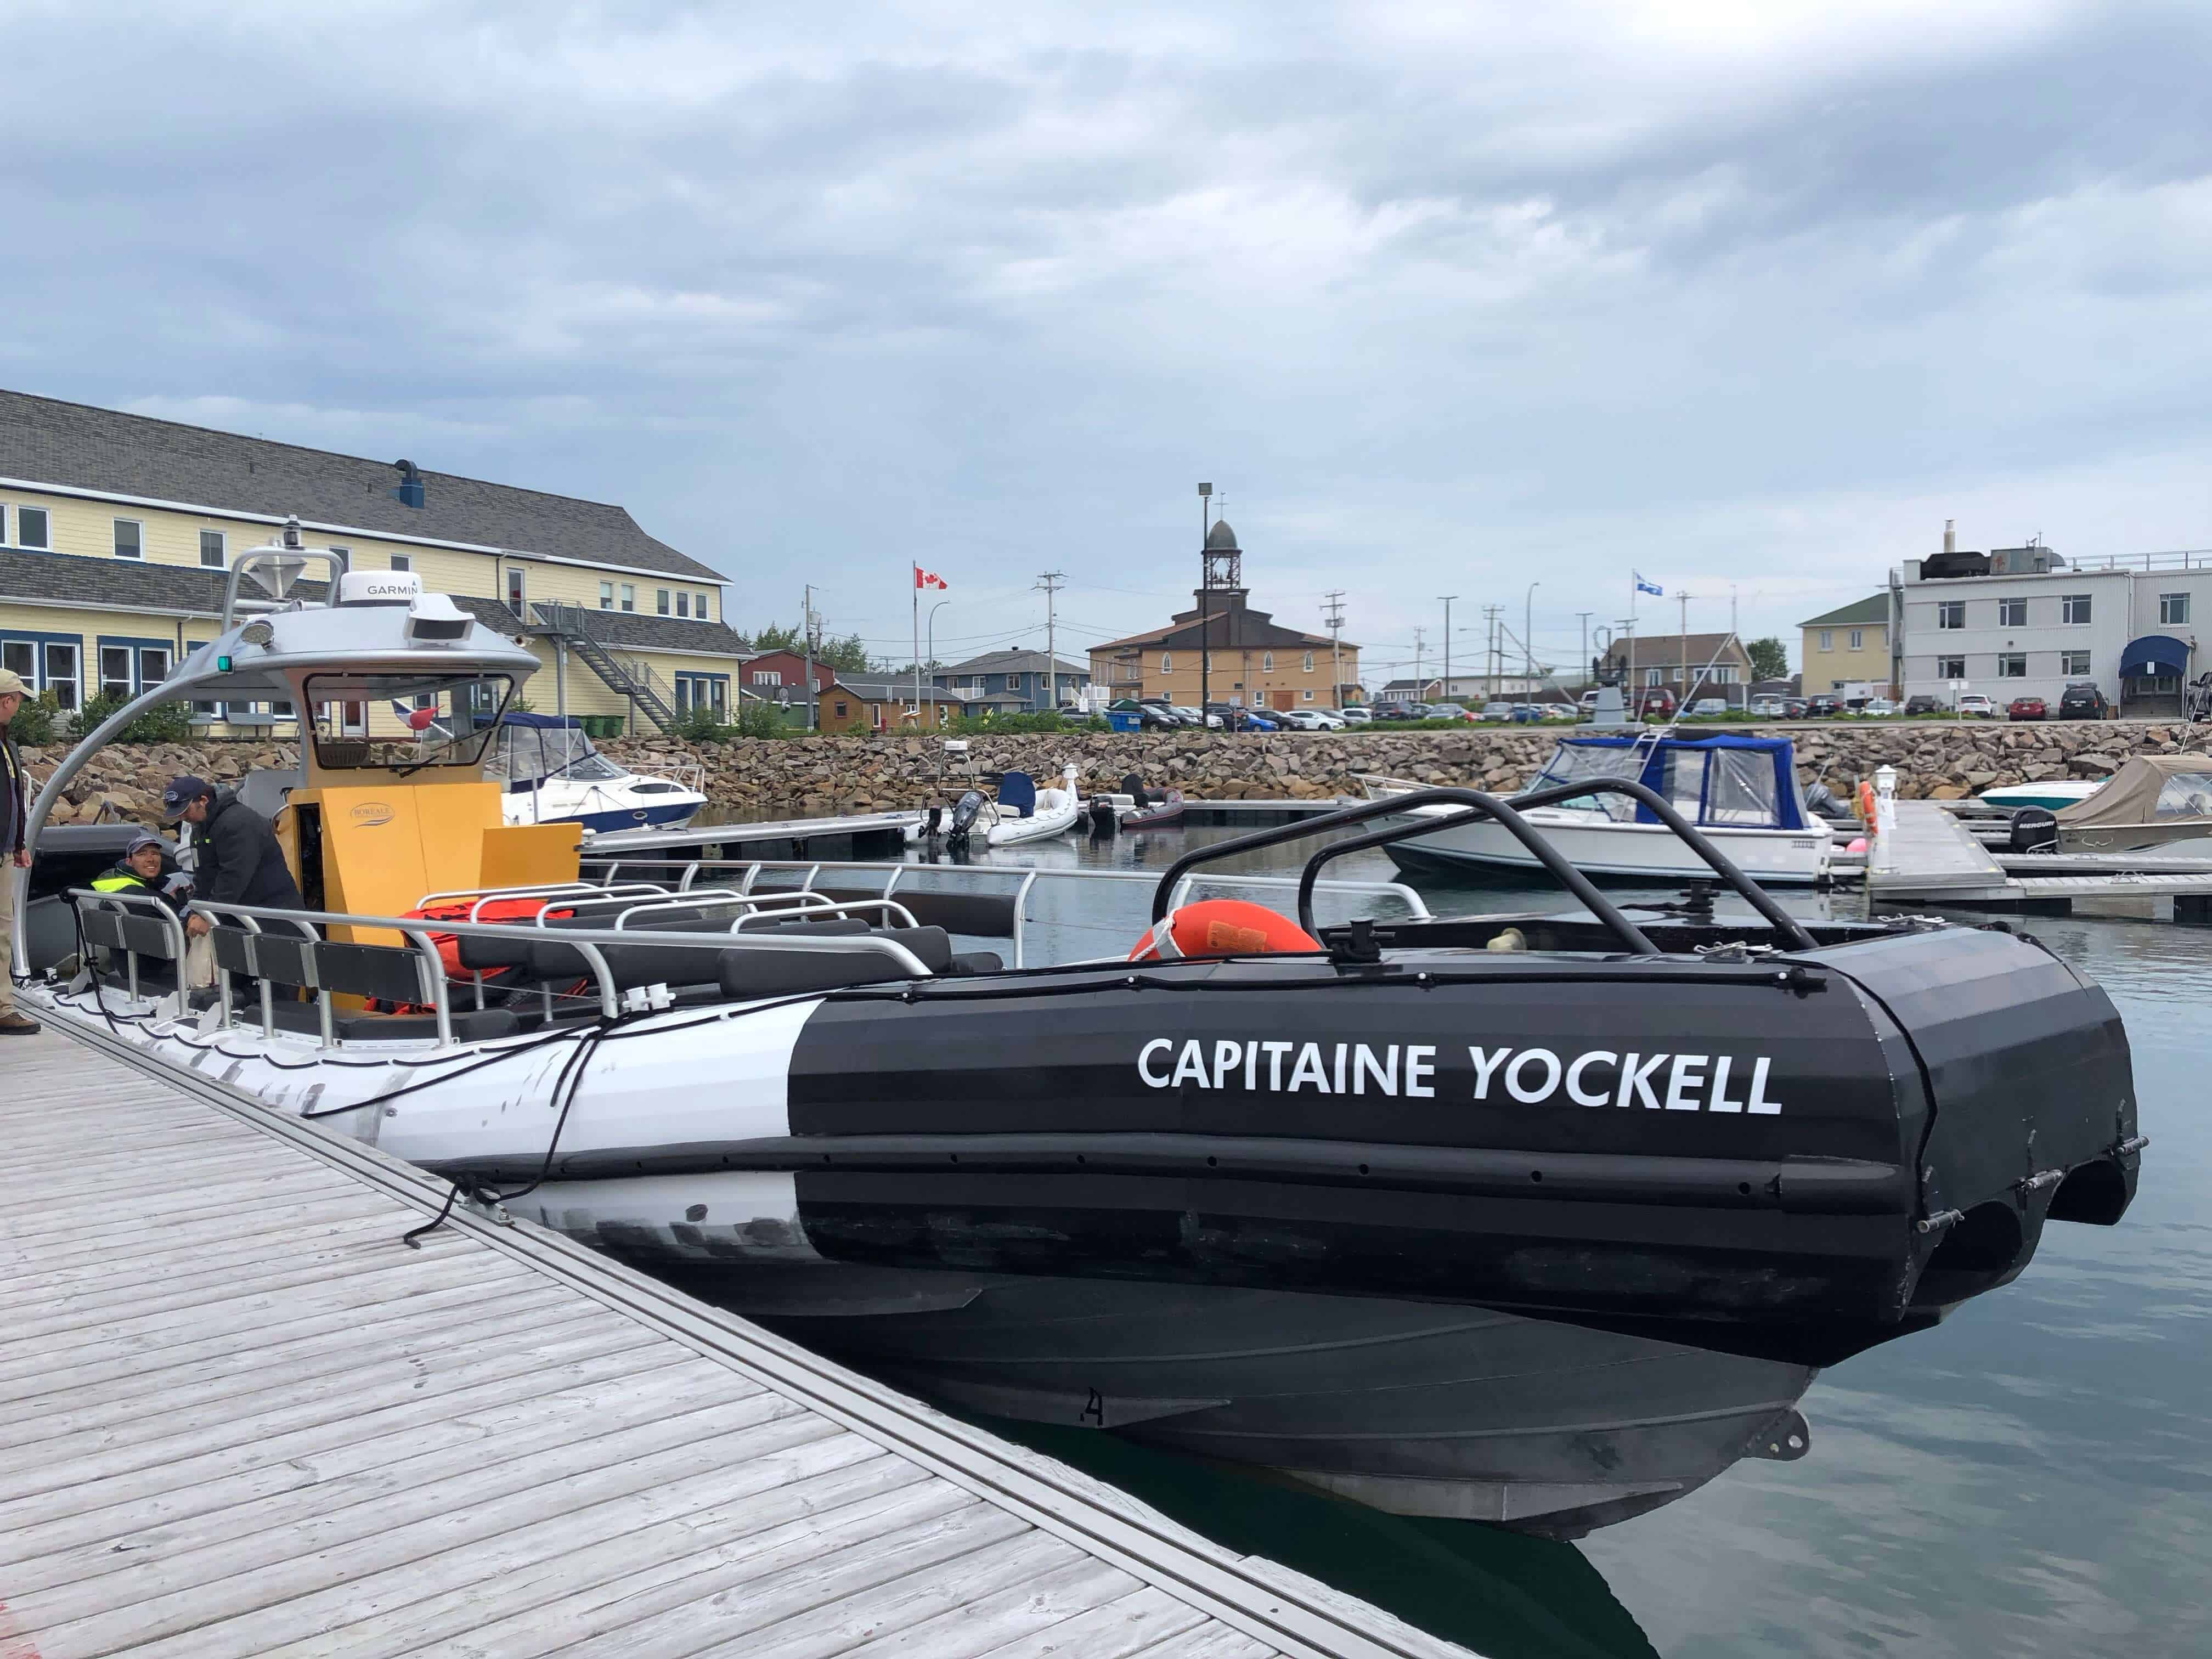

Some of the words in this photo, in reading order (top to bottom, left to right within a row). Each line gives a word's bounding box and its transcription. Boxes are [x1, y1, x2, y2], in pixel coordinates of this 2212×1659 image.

[368, 585, 418, 595] GARMIN
[1138, 1039, 1436, 1098] CAPITAINE
[1468, 1046, 1782, 1115] YOCKELL
